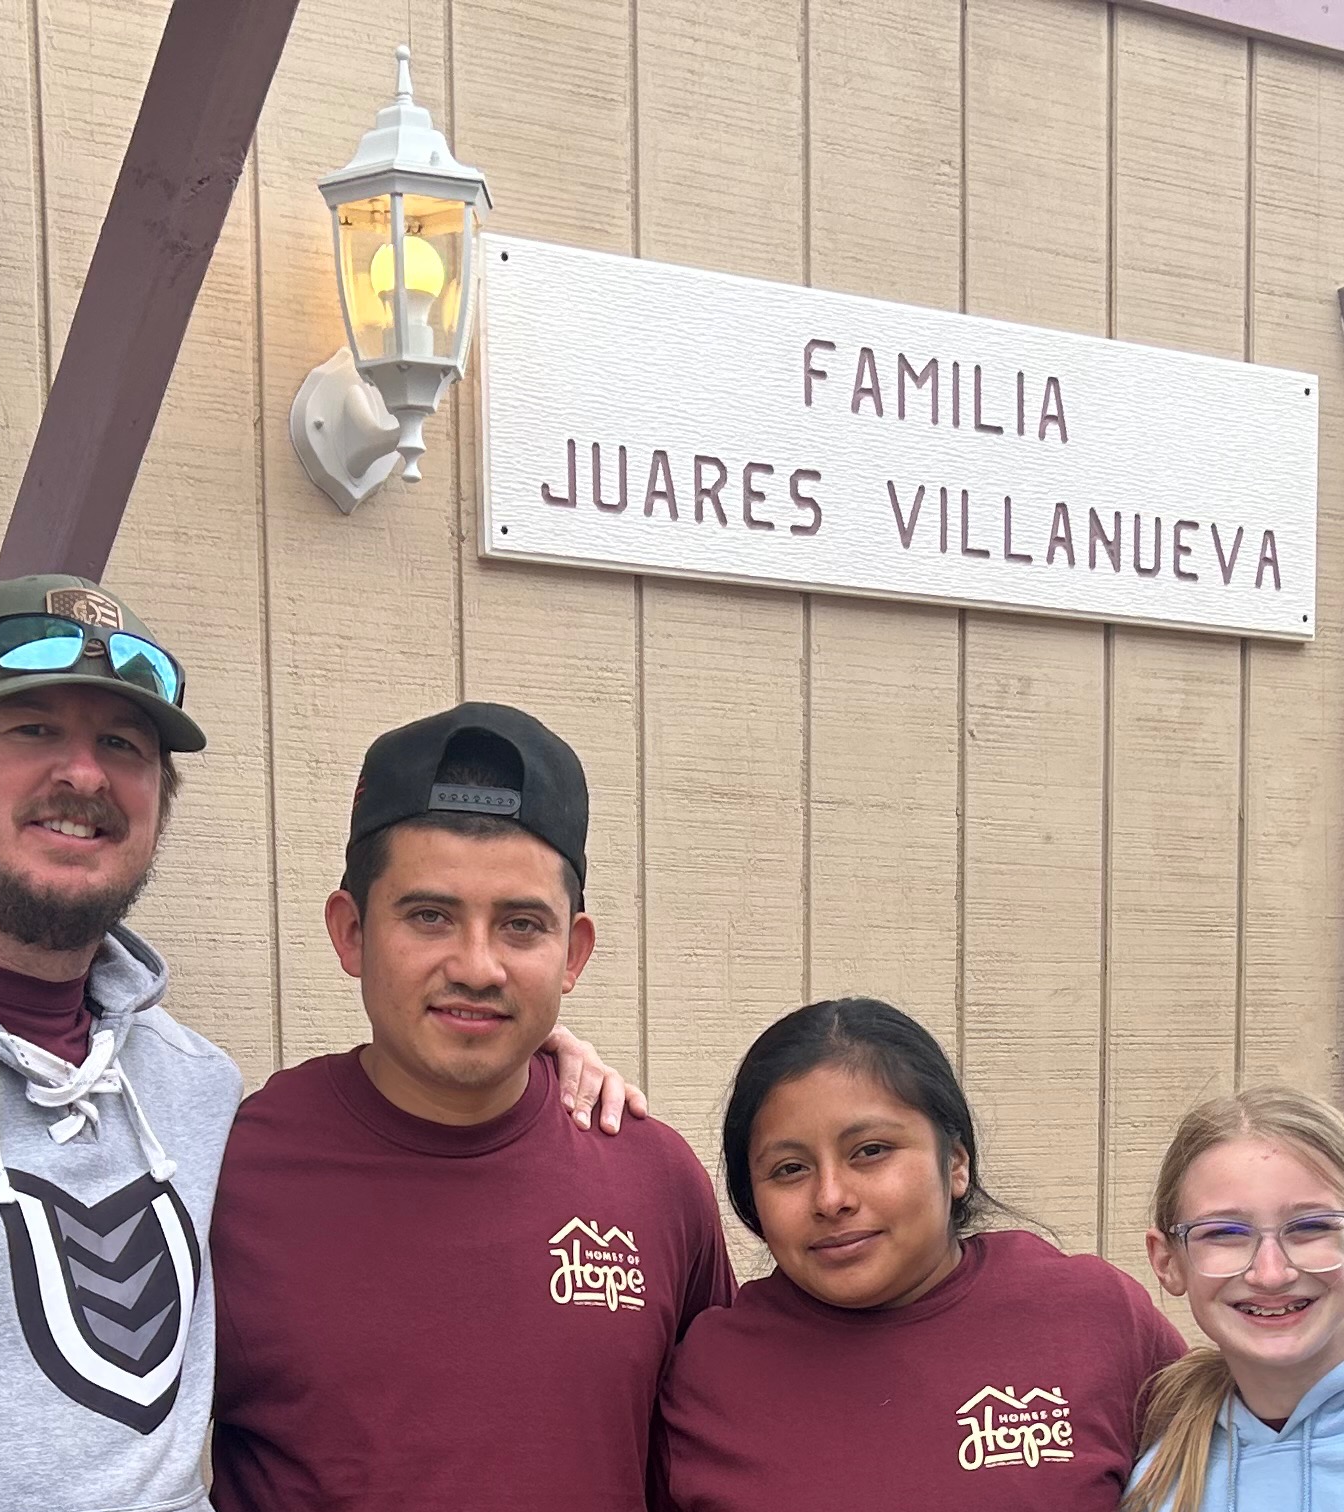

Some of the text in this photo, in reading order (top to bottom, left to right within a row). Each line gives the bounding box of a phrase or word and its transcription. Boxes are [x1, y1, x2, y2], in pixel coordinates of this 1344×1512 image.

[804, 338, 1069, 444] FAMILIA
[540, 438, 1282, 591] JUARES VILLANUEVA
[549, 1238, 646, 1312] Hope
[584, 1249, 640, 1266] HOMES OF
[956, 1405, 1074, 1471] Hope
[998, 1407, 1070, 1424] HOMES OF
